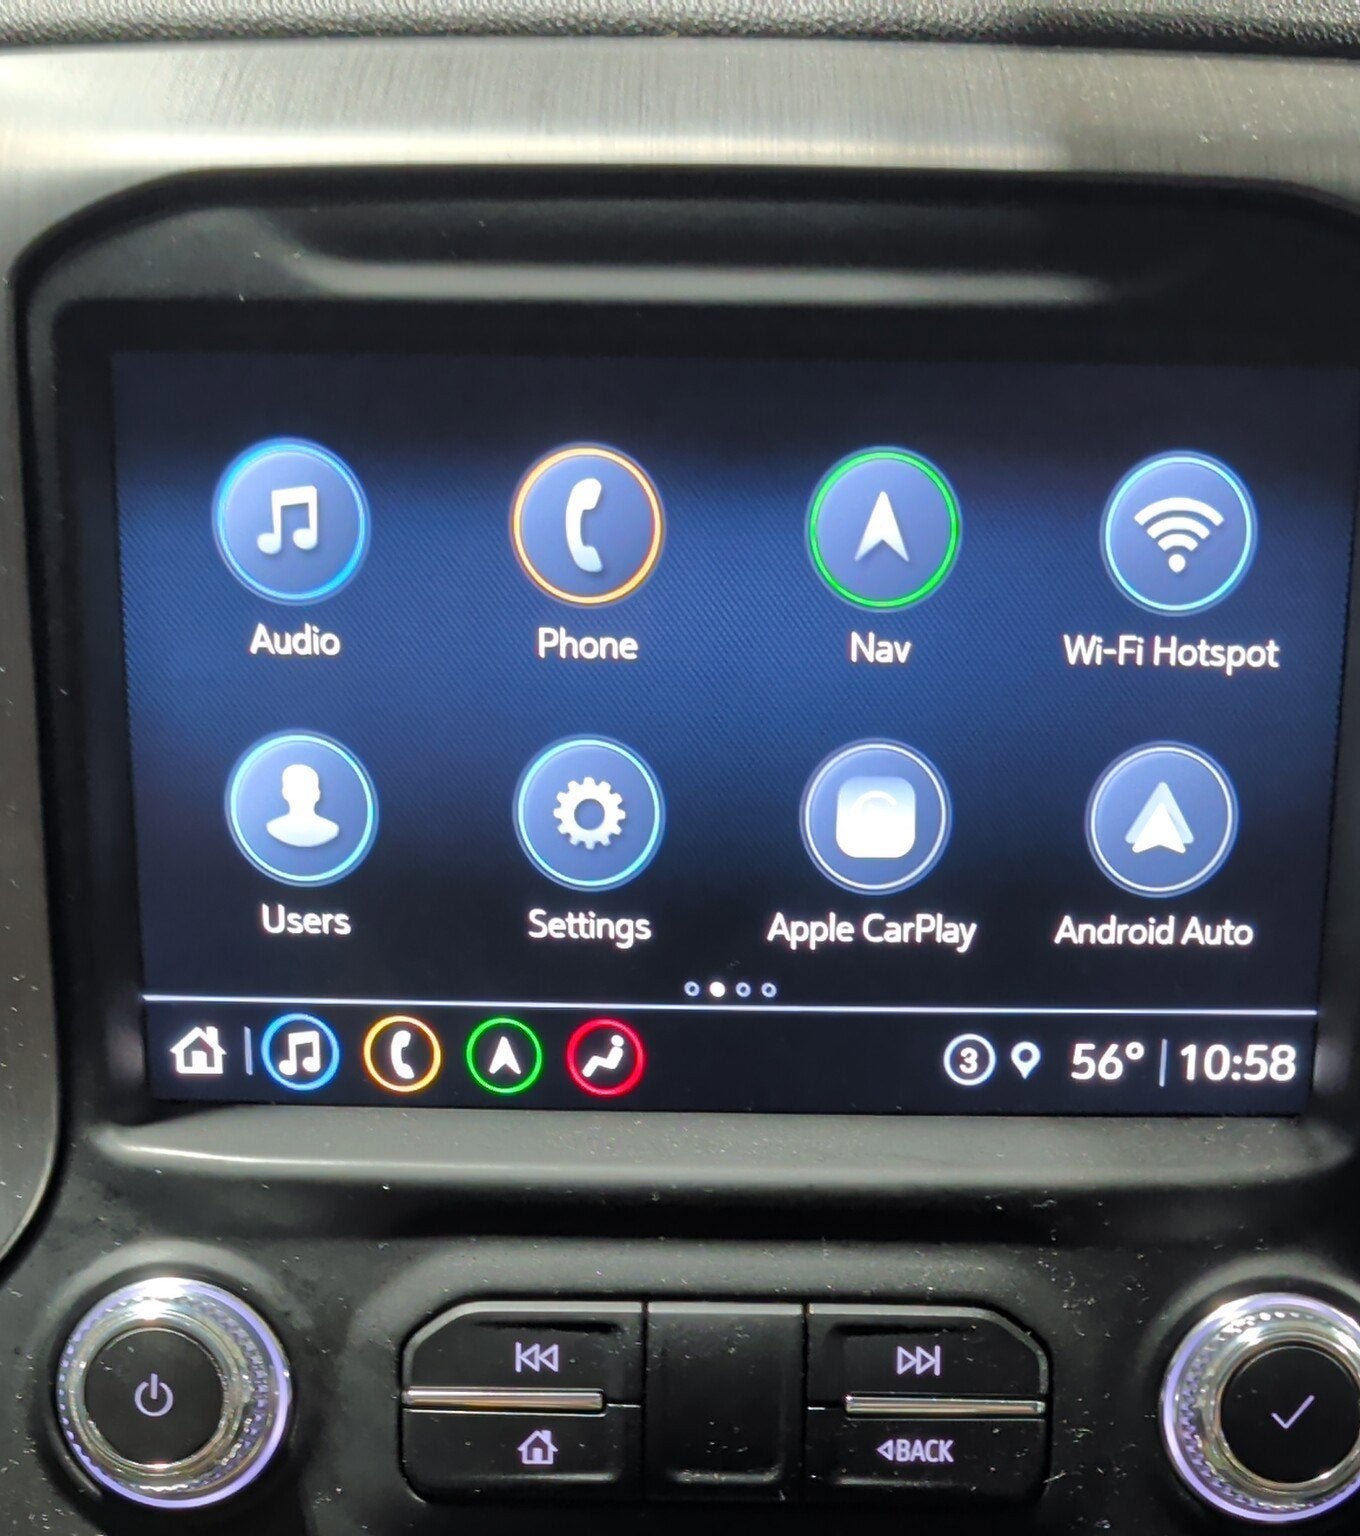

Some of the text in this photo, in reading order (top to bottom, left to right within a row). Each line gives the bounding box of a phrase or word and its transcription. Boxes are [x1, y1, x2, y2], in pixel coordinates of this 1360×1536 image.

[250, 624, 340, 656] Audio
[538, 628, 638, 660] Phone
[850, 632, 911, 664] Nav
[1063, 634, 1279, 675] Wi-Fi Hotspot
[262, 904, 351, 935] Users
[528, 910, 651, 948] Settings
[767, 913, 977, 952] Apple CarPlay
[1054, 916, 1254, 946] Android Auto
[959, 1048, 978, 1074] 3
[1180, 1044, 1296, 1082] 10:58
[895, 1439, 954, 1463] BACK
